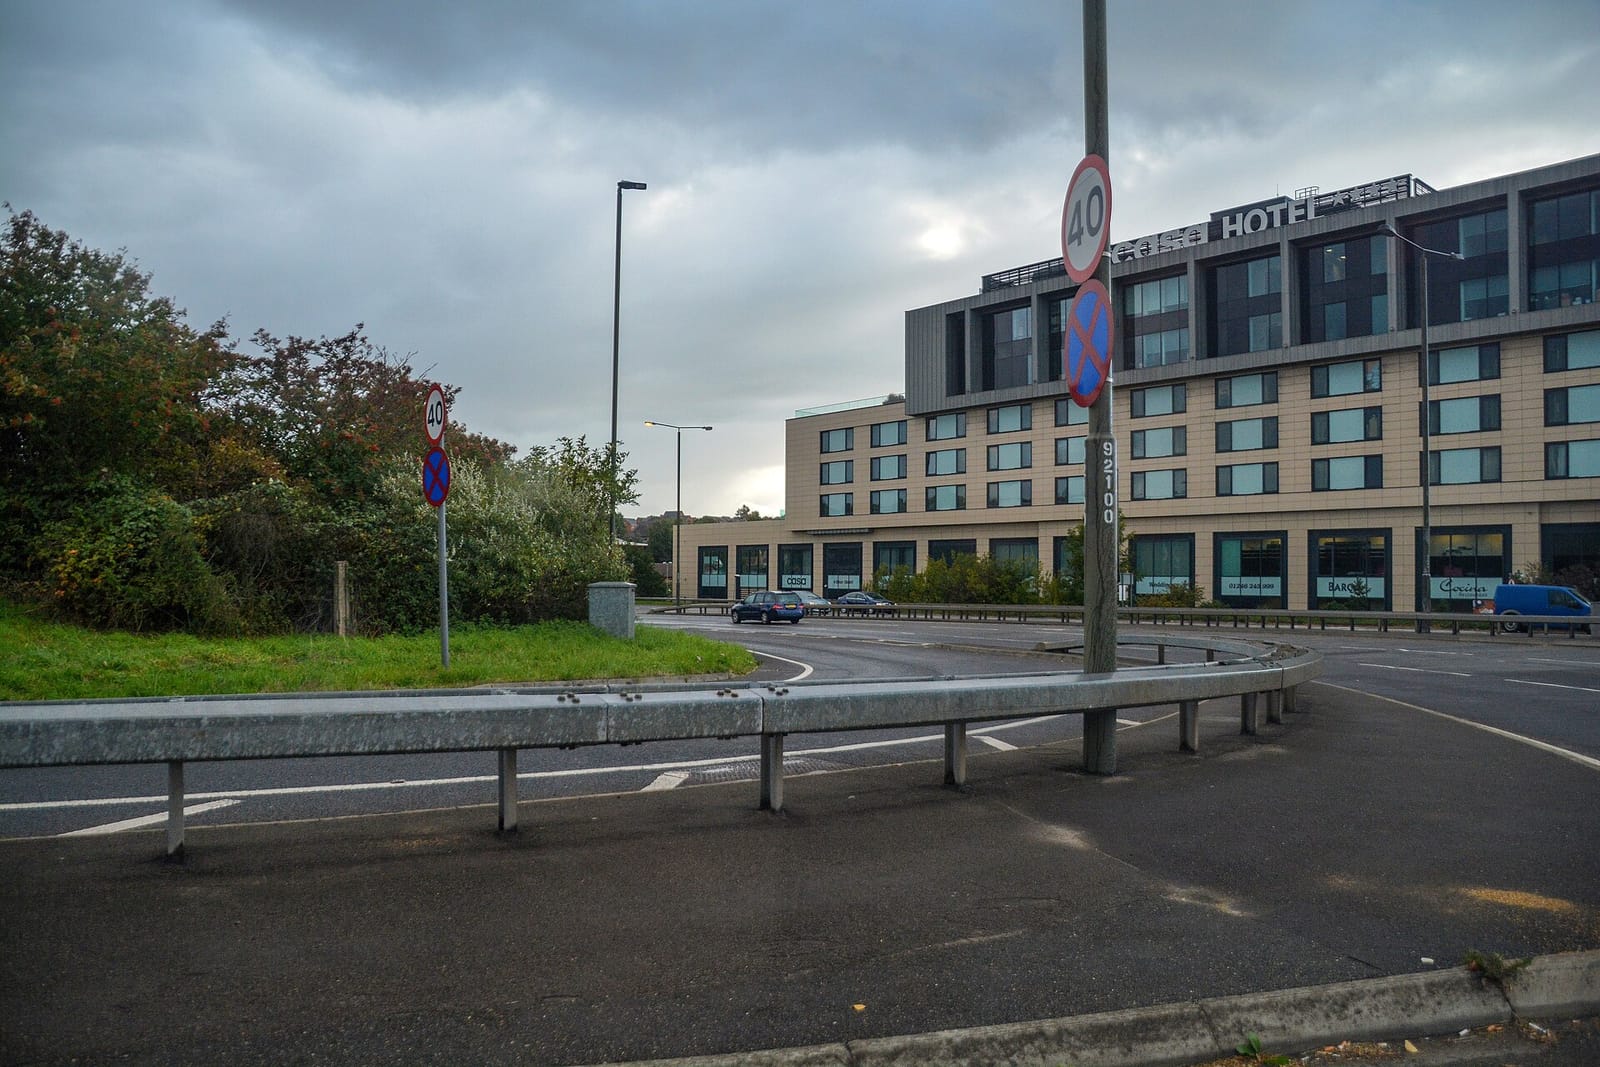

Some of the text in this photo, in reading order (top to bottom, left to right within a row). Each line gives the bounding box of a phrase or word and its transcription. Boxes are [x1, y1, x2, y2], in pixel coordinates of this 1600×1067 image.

[1067, 185, 1104, 246] 40
[1222, 196, 1325, 239] HOTEL
[428, 401, 443, 427] 40
[1103, 441, 1114, 524] 92100
[787, 577, 807, 586] casa
